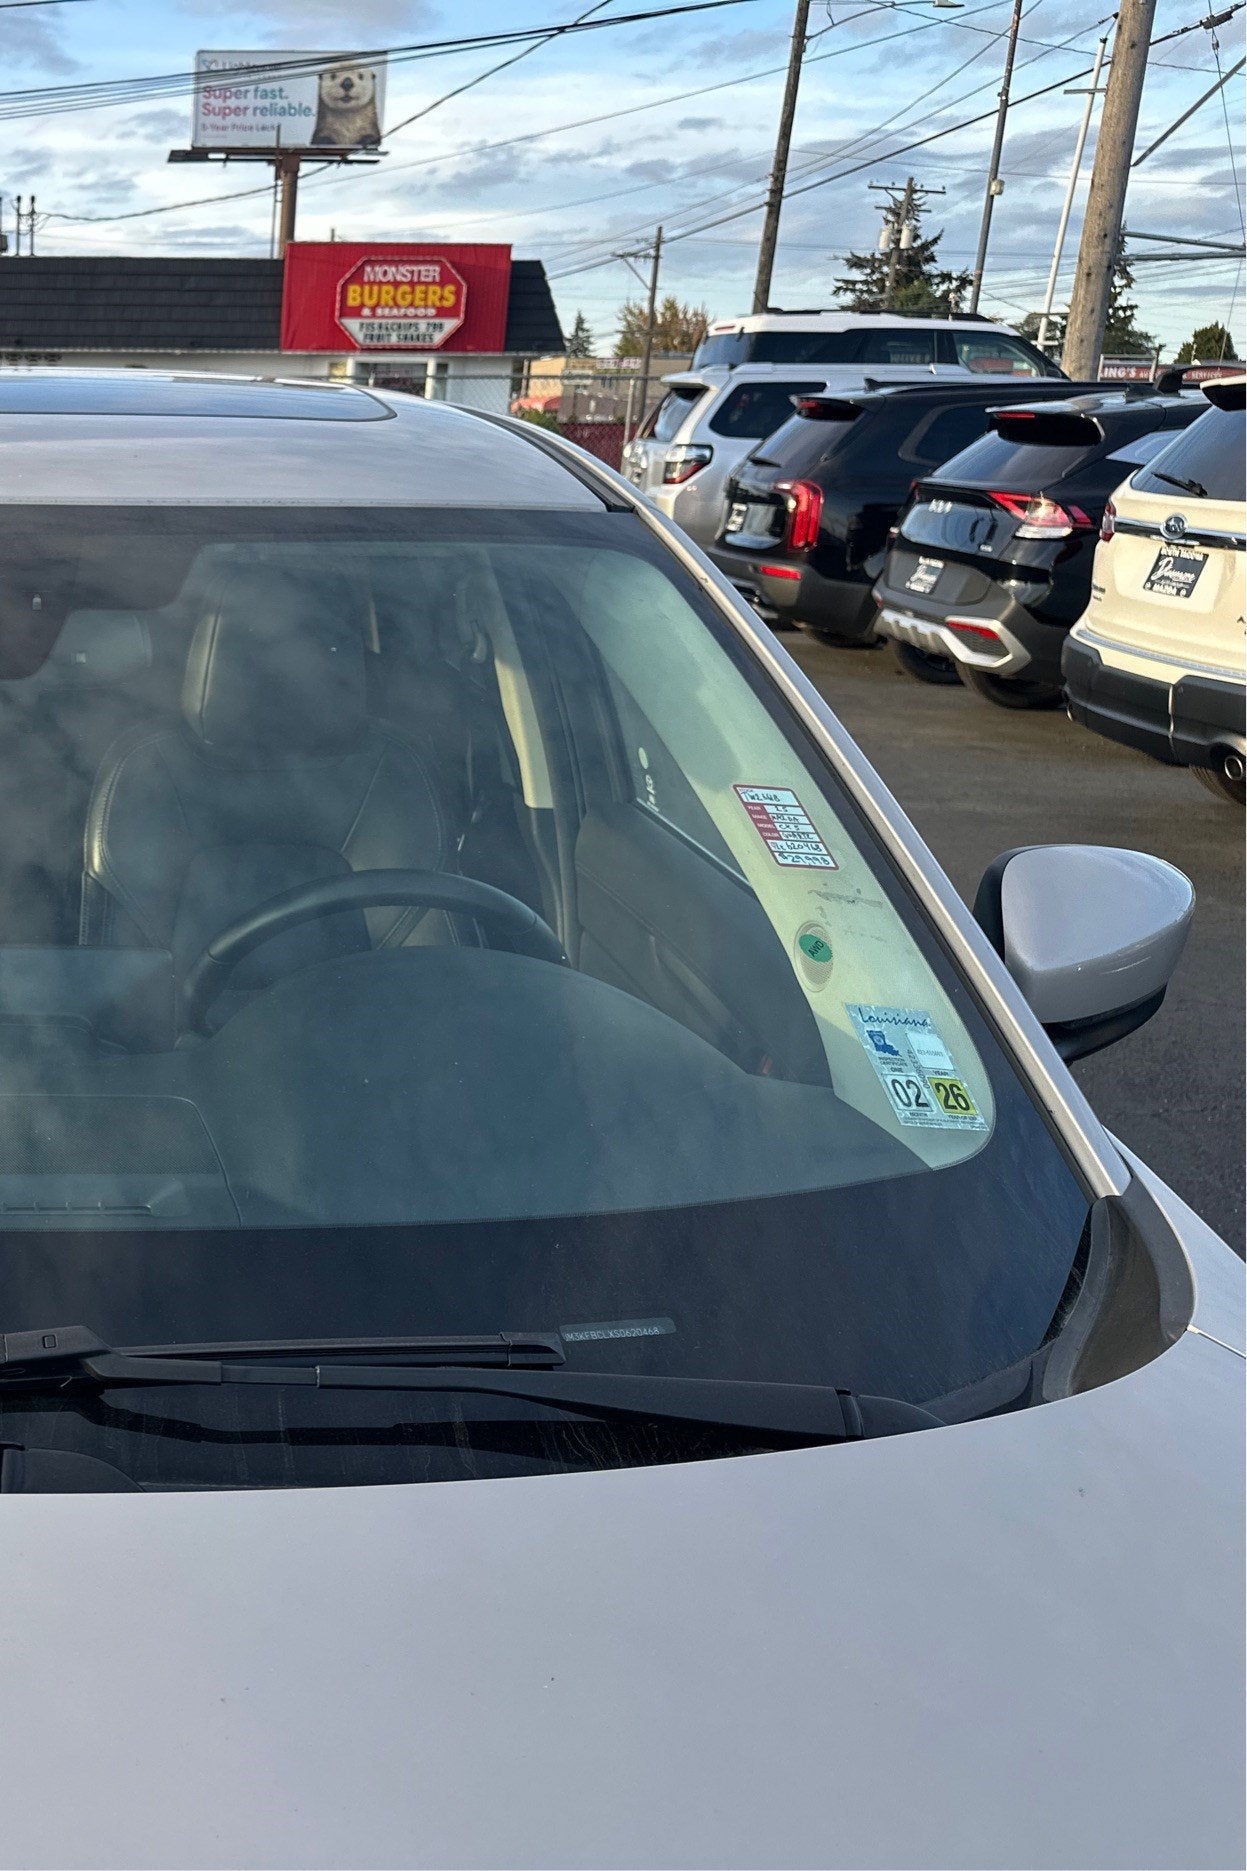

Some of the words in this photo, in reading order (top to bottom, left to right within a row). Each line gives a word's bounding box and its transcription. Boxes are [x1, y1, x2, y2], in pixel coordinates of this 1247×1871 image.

[202, 86, 250, 102] Super
[253, 86, 289, 100] fast.
[202, 102, 249, 120] Super
[252, 102, 316, 117] reliable.
[363, 264, 440, 283] MONSTER
[346, 284, 457, 308] BURGERS
[360, 307, 372, 317] &
[375, 307, 436, 317] SEAFOOD
[807, 940, 824, 957] AWD
[858, 1007, 931, 1027] Louisiana
[891, 1078, 929, 1108] 02
[934, 1082, 970, 1111] 26
